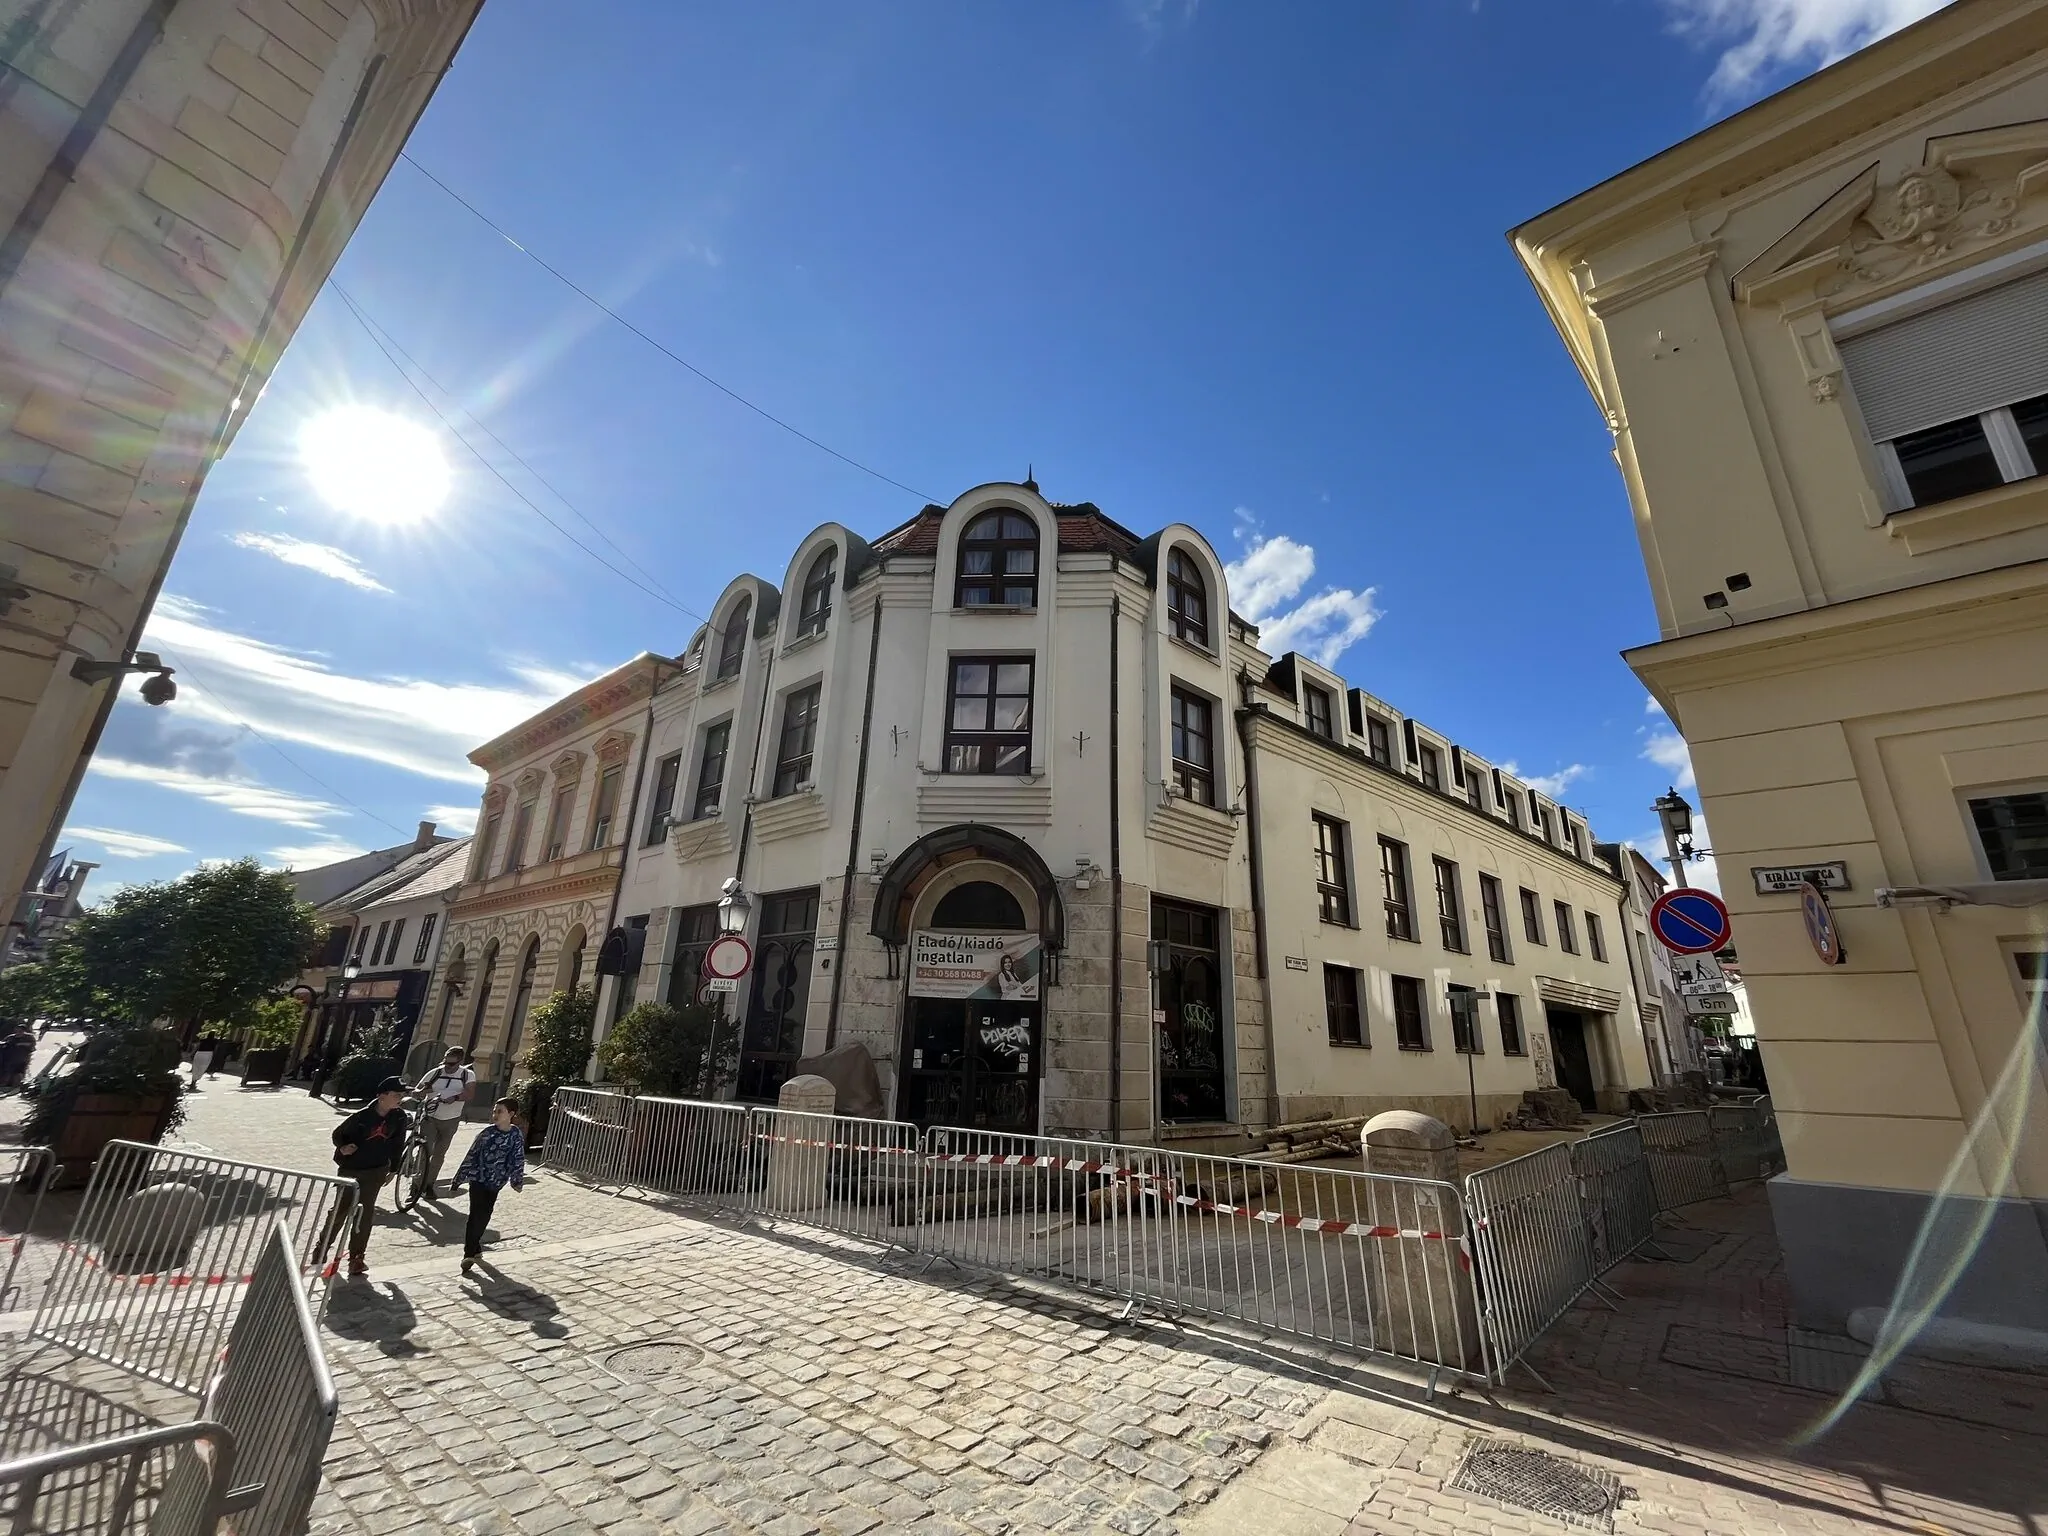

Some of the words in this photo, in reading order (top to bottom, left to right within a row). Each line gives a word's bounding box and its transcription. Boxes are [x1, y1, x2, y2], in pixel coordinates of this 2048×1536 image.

[1764, 869, 1800, 882] KIRÁLY
[918, 936, 1004, 950] Eladó/kiadó
[917, 949, 974, 965] ingatlan
[944, 970, 960, 978] 568
